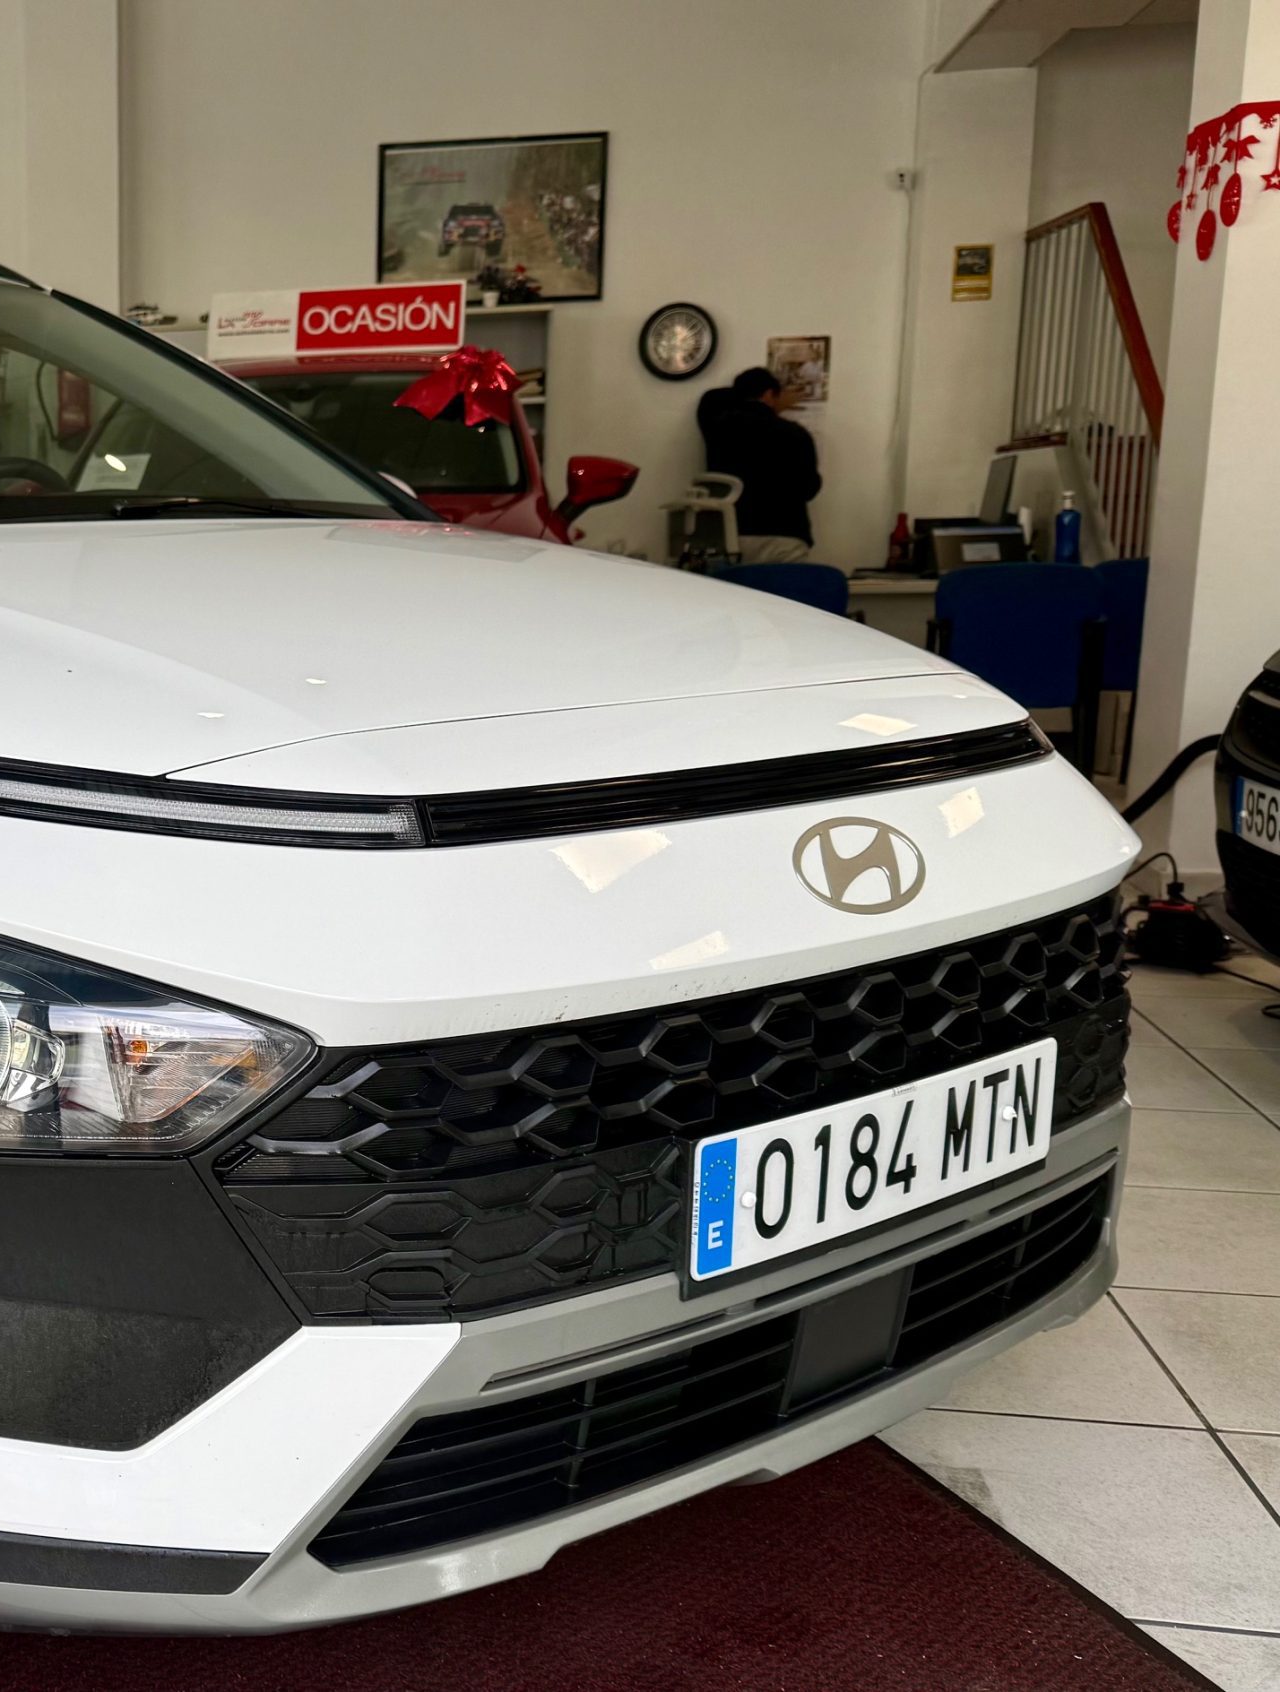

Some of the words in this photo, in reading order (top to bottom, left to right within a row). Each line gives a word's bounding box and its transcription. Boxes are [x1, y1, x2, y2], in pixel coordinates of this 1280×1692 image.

[302, 295, 456, 335] OCASIÓN
[1246, 788, 1280, 843] 956
[754, 1099, 917, 1239] 0184
[941, 1057, 1041, 1181] MTN
[707, 1219, 724, 1250] E
